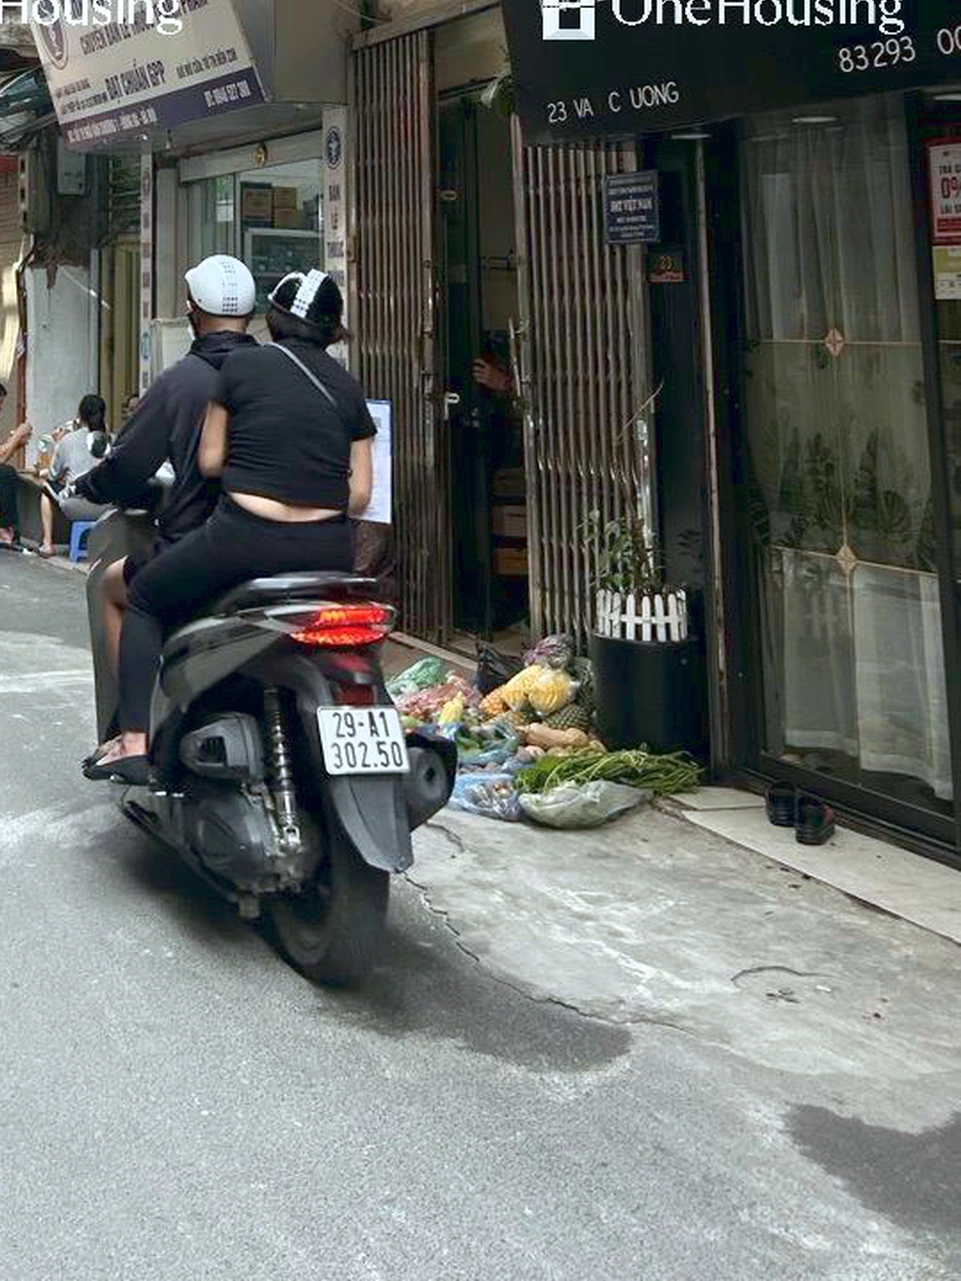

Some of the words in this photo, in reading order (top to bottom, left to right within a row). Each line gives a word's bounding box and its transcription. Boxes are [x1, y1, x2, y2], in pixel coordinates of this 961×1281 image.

[839, 35, 916, 73] 83293
[547, 101, 567, 123] 23
[332, 710, 391, 738] 29-A1
[330, 741, 404, 770] 302.50
